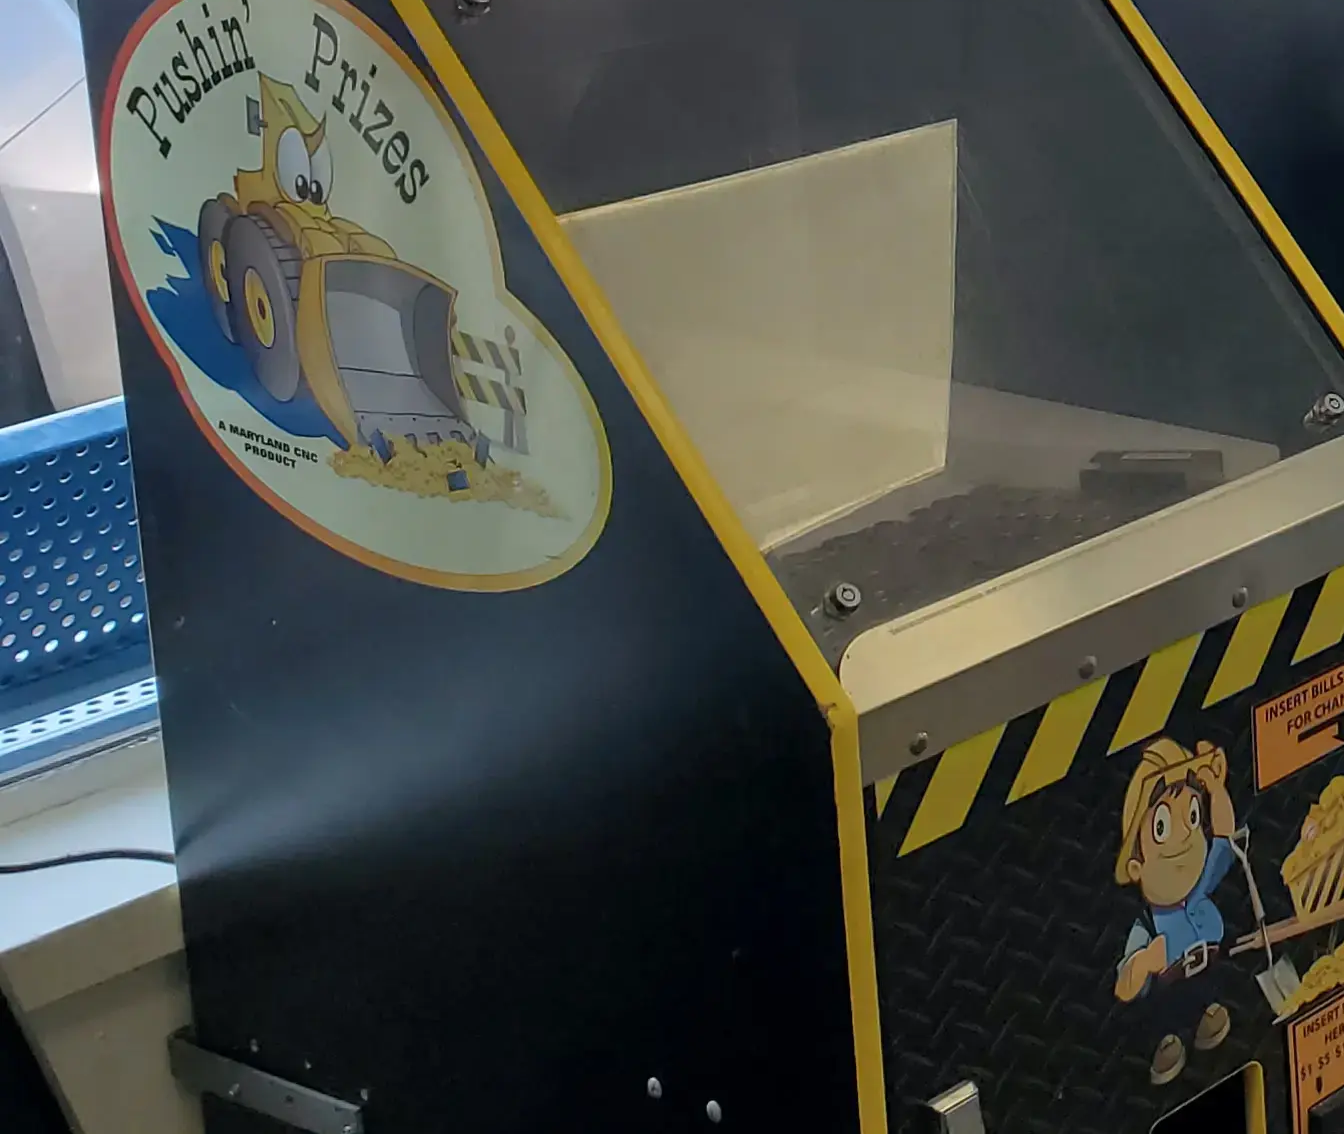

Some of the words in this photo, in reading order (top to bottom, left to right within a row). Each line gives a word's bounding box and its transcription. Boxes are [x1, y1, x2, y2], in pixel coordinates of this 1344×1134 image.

[304, 13, 429, 204] Prizes
[218, 420, 226, 431] A
[229, 424, 290, 453] MARYLAND
[294, 446, 318, 463] CNC
[244, 442, 297, 469] PRODUCT
[1265, 689, 1309, 723] INSERT
[1311, 671, 1344, 699] BILLS
[1287, 710, 1312, 735] FOR
[1303, 1006, 1339, 1038] INSERT
[1300, 1064, 1312, 1081] $1
[1318, 1052, 1331, 1070] $5
